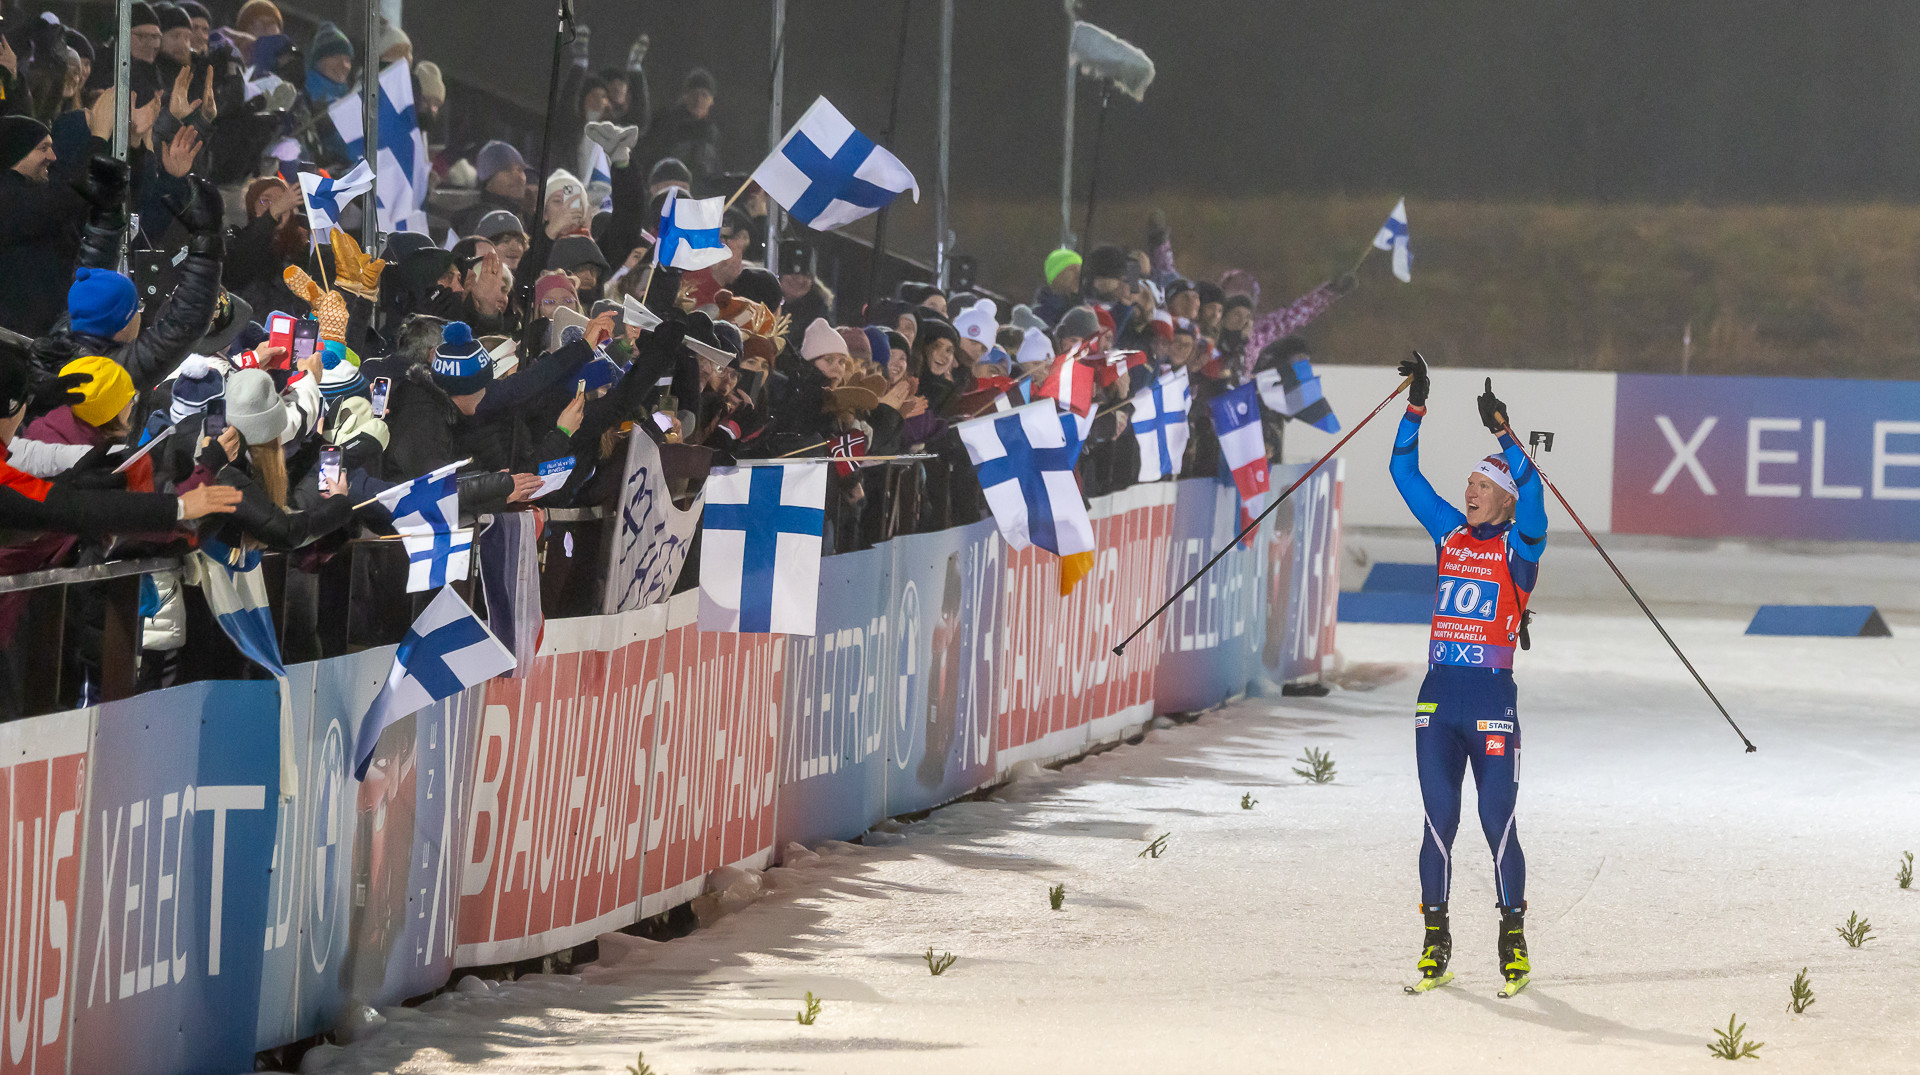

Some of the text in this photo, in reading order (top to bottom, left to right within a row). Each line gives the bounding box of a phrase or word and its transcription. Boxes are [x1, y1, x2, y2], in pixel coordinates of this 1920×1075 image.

[1446, 546, 1502, 562] VIESSMANN
[1444, 562, 1493, 576] Heat pumps
[1439, 579, 1493, 618] 10 4
[1437, 621, 1483, 633] KONTIOLAHTI
[1433, 630, 1487, 642] NORTH KARELIA
[962, 529, 1000, 772] X3
[1455, 643, 1484, 664] X3
[1488, 722, 1513, 731] STARK
[1486, 739, 1504, 751] Rex
[460, 679, 658, 896] BAUHAUS
[647, 638, 785, 852] BAUHAUS
